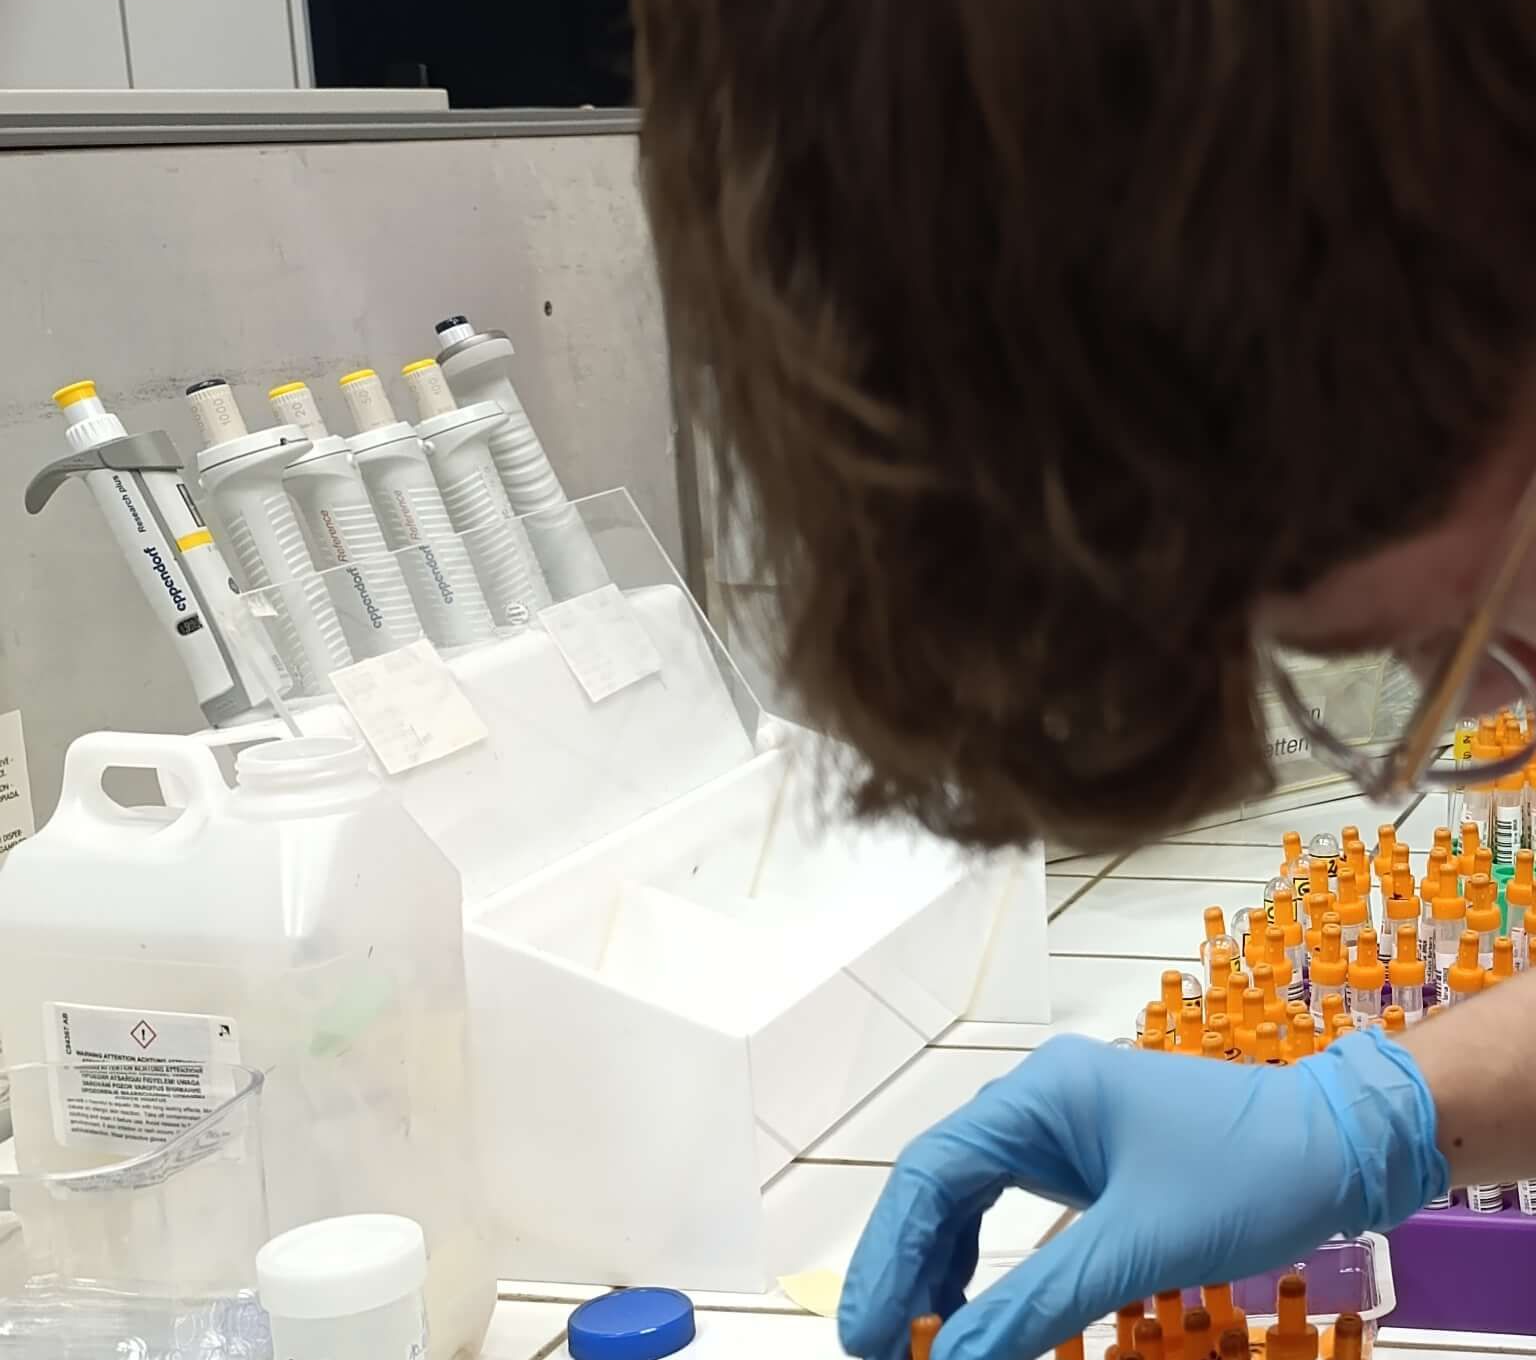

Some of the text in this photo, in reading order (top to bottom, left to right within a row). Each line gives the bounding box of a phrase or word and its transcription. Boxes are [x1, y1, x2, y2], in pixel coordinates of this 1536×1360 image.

[292, 401, 306, 417] 20
[112, 474, 187, 612] eppendorf Research plus
[346, 566, 382, 629] eppendorf
[418, 544, 454, 605] eppendorf
[103, 1053, 136, 1062] ATTENTION
